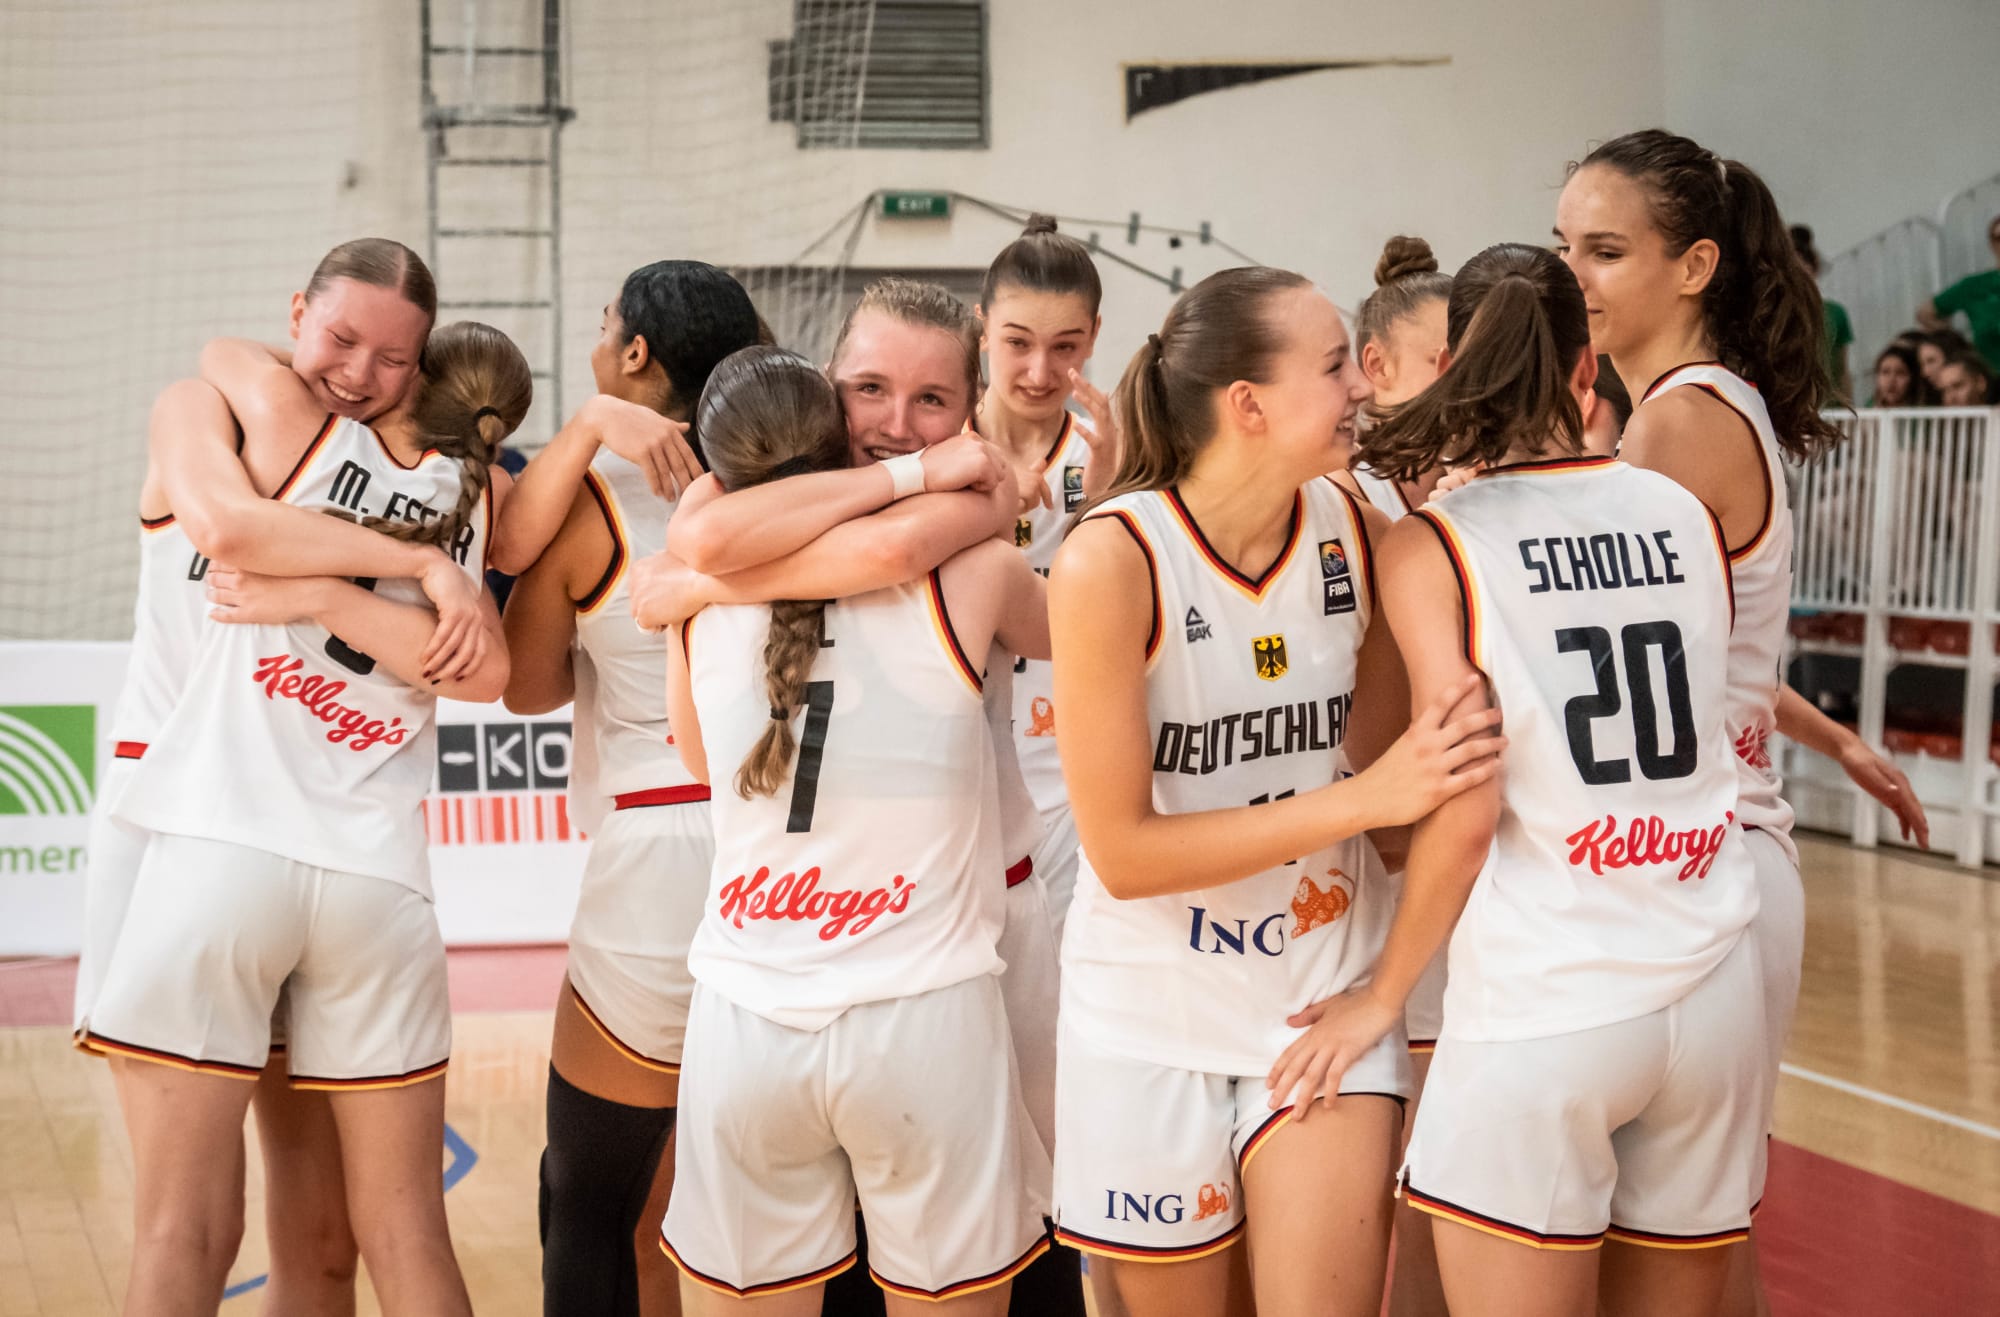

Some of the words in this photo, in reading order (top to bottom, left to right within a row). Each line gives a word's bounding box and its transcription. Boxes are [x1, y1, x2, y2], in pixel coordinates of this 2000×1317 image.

[328, 459, 372, 515] M.
[1328, 581, 1351, 598] FIBA
[1518, 530, 1685, 594] SCHOLLE
[252, 654, 409, 752] Kellogg's
[1555, 620, 1698, 786] 20
[786, 681, 835, 833] 7
[719, 866, 917, 941] Kellogg's
[1187, 906, 1286, 957] ING
[1104, 1190, 1185, 1225] ING
